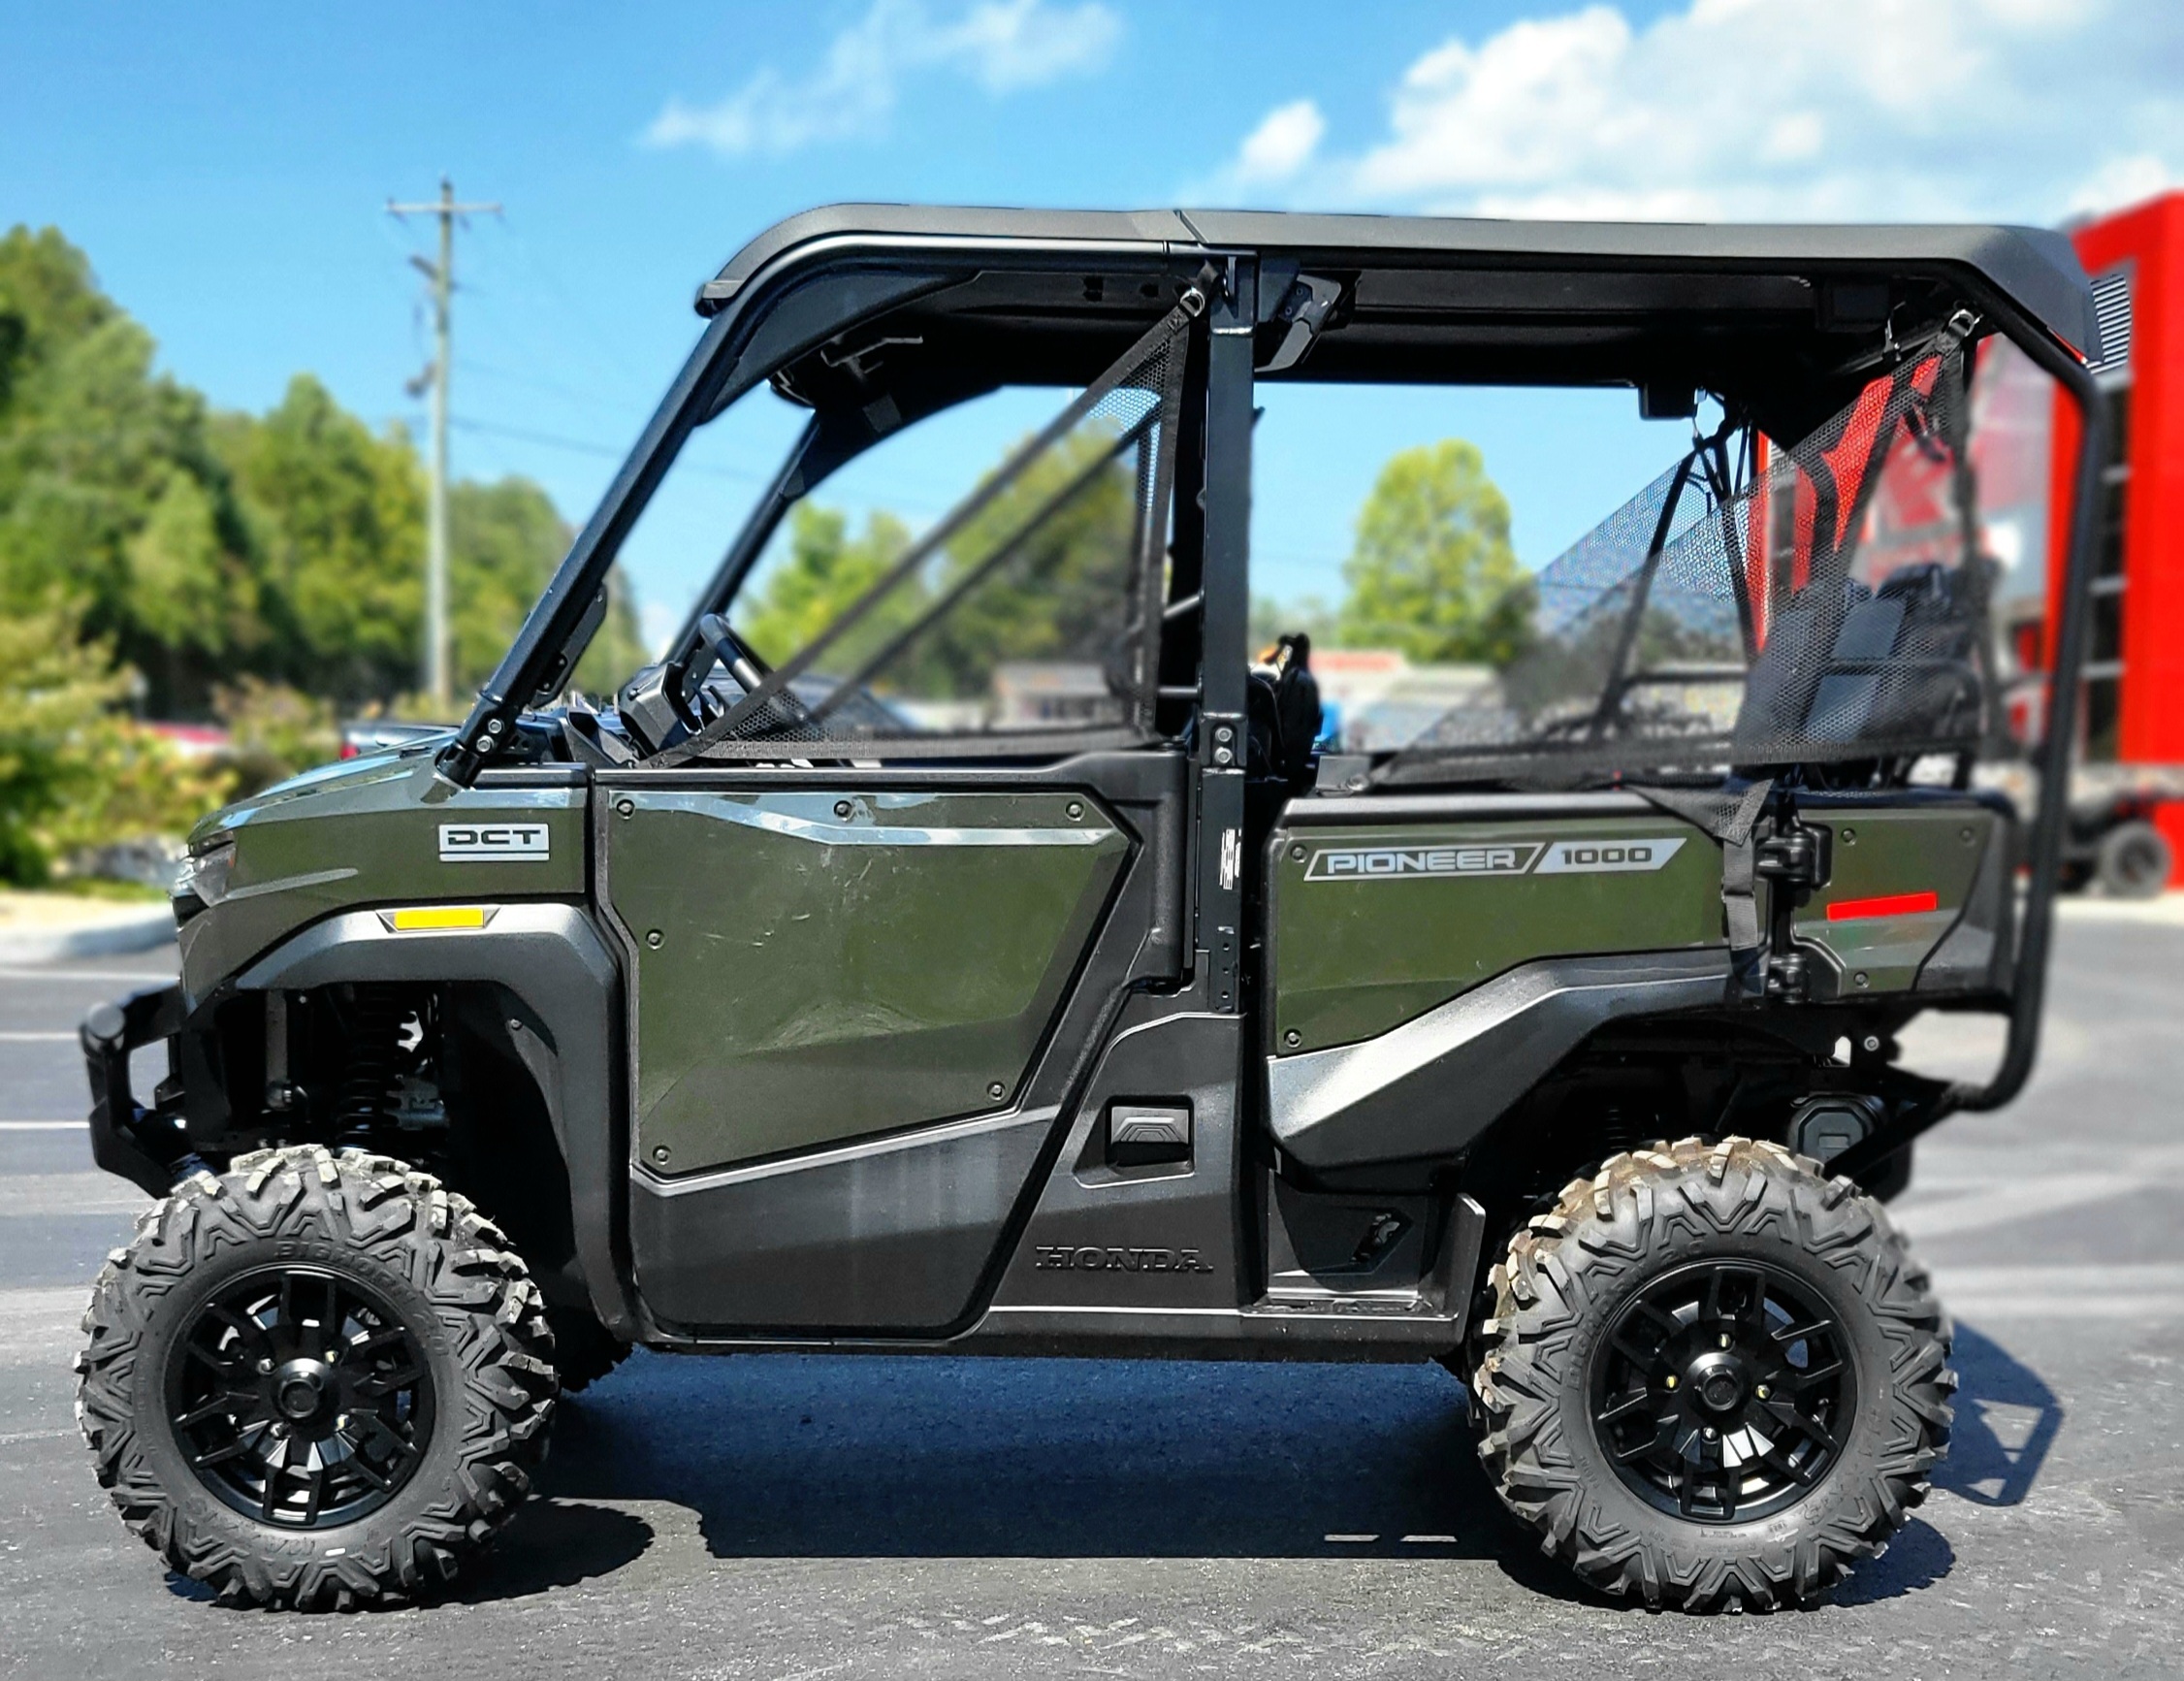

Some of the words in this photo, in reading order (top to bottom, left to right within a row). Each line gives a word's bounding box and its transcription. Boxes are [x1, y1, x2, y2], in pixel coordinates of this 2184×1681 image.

[447, 829, 541, 846] DCT
[1326, 848, 1518, 875] PIONEER
[1560, 847, 1654, 865] 1000
[1035, 1245, 1214, 1273] HONDA
